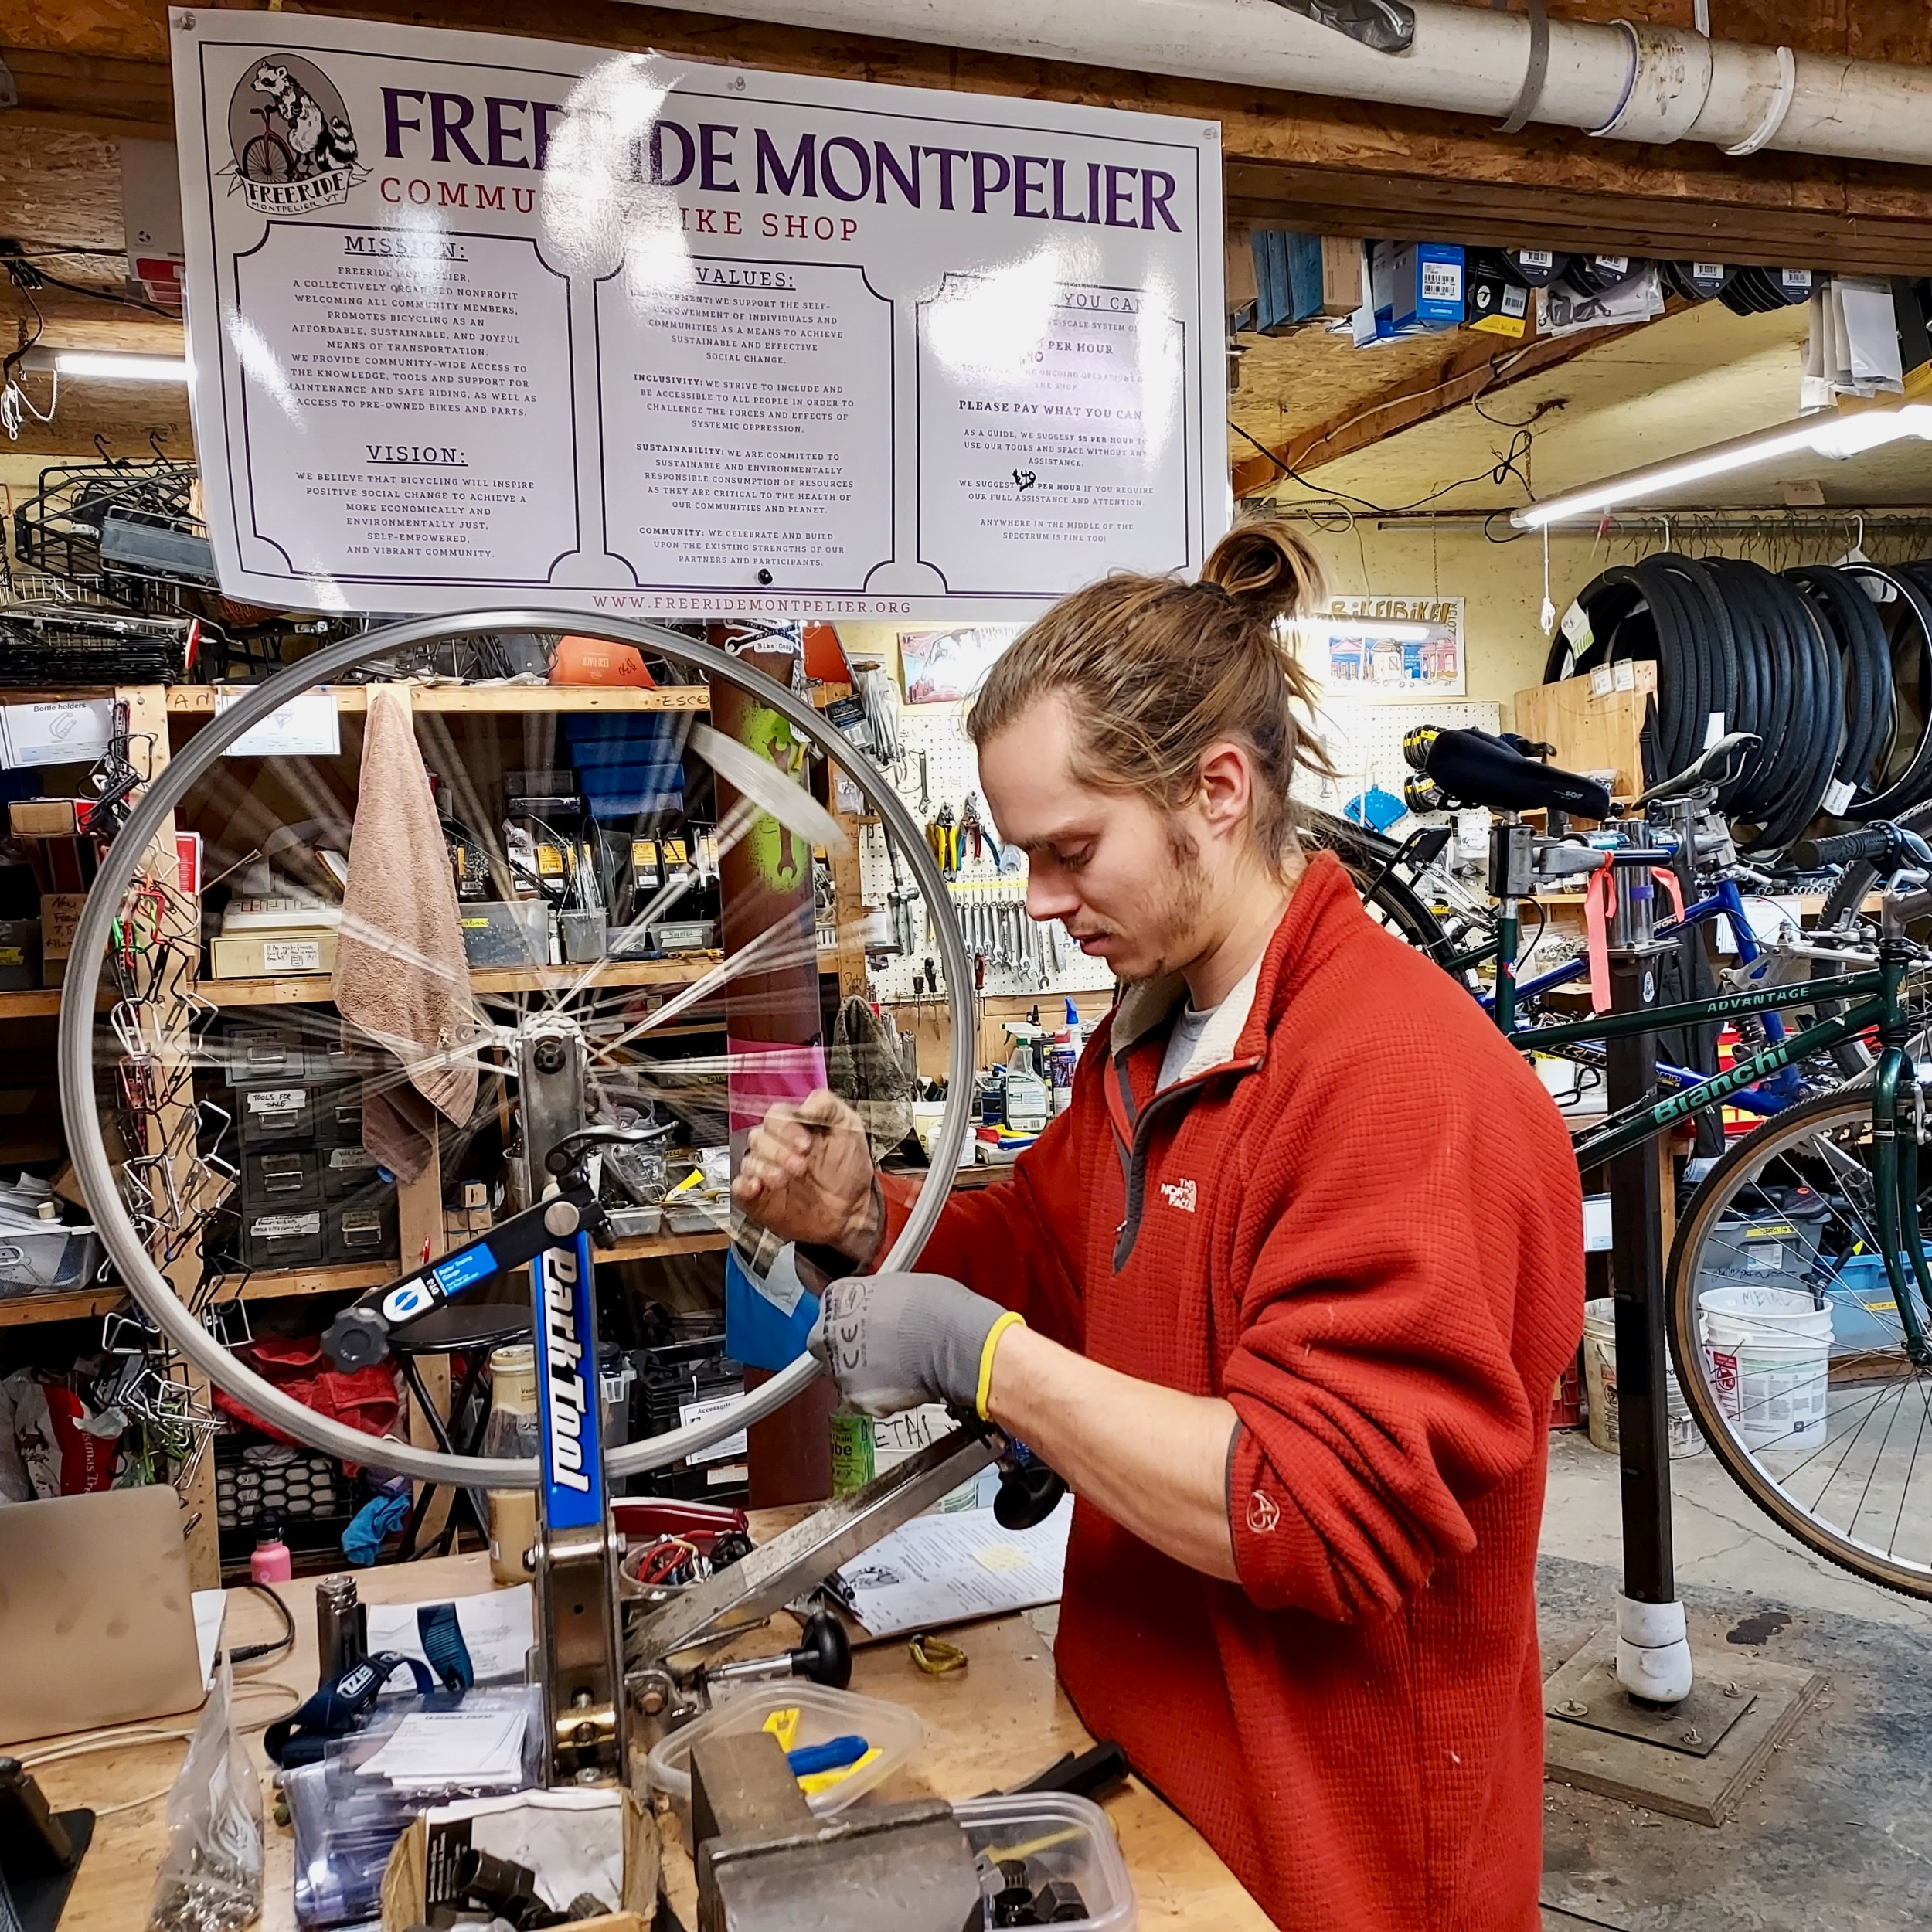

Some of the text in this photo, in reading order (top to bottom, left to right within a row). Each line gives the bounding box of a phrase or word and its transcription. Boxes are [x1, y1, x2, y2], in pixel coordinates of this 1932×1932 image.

[754, 127, 1183, 233] MONTPELIER
[247, 172, 346, 205] FREERIDE
[251, 200, 321, 213] MONTPELIER
[761, 213, 860, 242] SHOP
[338, 266, 393, 277] FREERIDE
[695, 267, 795, 288] VALUES:
[1063, 292, 1101, 309] YOU
[328, 311, 386, 321] PROMOTES
[389, 314, 448, 325] BICYCLING
[470, 318, 484, 327] AN
[291, 324, 520, 344] AFFORDABLE, SUSTAINABLE, AND JOYFUL
[327, 341, 488, 356] MEANS OF TRANSPORTATION.
[671, 335, 818, 352] SUSTAINABLE AND EFFECTIVE
[1048, 340, 1114, 355] PER HOUR
[291, 353, 527, 373] WE PROVIDE COMMUNITY-WIDE ACCESS TO
[706, 352, 786, 364] SOCIAL CHANGE.
[634, 373, 702, 386] INCLUSIVITY:
[706, 379, 719, 388] WE
[723, 381, 757, 390] STRIVE
[777, 383, 819, 393] INCLUDE
[297, 398, 527, 417] ACCESS TO PRE-OWNED BIKES AND PARTS.
[958, 400, 1010, 413] PLEASE
[1013, 403, 1039, 414] PAY
[1043, 405, 1082, 418] WHAT
[1086, 408, 1113, 419] YOU
[692, 420, 804, 433] SYSTEMIC OPPRESSION.
[366, 444, 467, 464] VISION:
[636, 443, 724, 455] SUSTAINABILITY:
[727, 449, 741, 457] WE
[767, 451, 824, 461] COMMITTED
[655, 459, 721, 470] SUSTAINABLE
[747, 464, 842, 474] ENVIRONMENTALLY
[317, 473, 363, 482] BELIEVE
[367, 475, 396, 484] THAT
[400, 476, 458, 485] BICYCLING
[462, 478, 488, 487] WILL
[493, 480, 534, 489] INSPIRE
[645, 472, 709, 482] RESPONSIBLE
[712, 476, 780, 486] CONSUMPTION
[799, 479, 853, 488] RESOURCES
[1015, 495, 1069, 504] ASSISTANCE
[345, 503, 376, 512] MORE
[380, 504, 464, 514] ECONOMICALLY
[695, 502, 761, 512] COMMUNITIES
[788, 505, 827, 514] PLANET.
[346, 517, 488, 530] ENVIRONMENTALLY JUST,
[367, 532, 470, 543] SELF-EMPOWERED,
[639, 527, 704, 536] COMMUNITY:
[726, 530, 779, 539] CELEBRATE
[1002, 532, 1049, 540] SPECTRUM
[347, 546, 495, 558] AND VIBRANT COMMUNITY.
[679, 555, 726, 563] PARTNERS
[753, 557, 823, 566] PARTICIPANTS.
[593, 594, 912, 615] WWW.FREERIDEMONTPELIER.ORG
[33, 701, 87, 713] Bottle holders
[1706, 986, 1811, 1013] ADVANTAGE
[1652, 1045, 1791, 1125] Bianchi
[697, 1402, 732, 1415] Accessori
